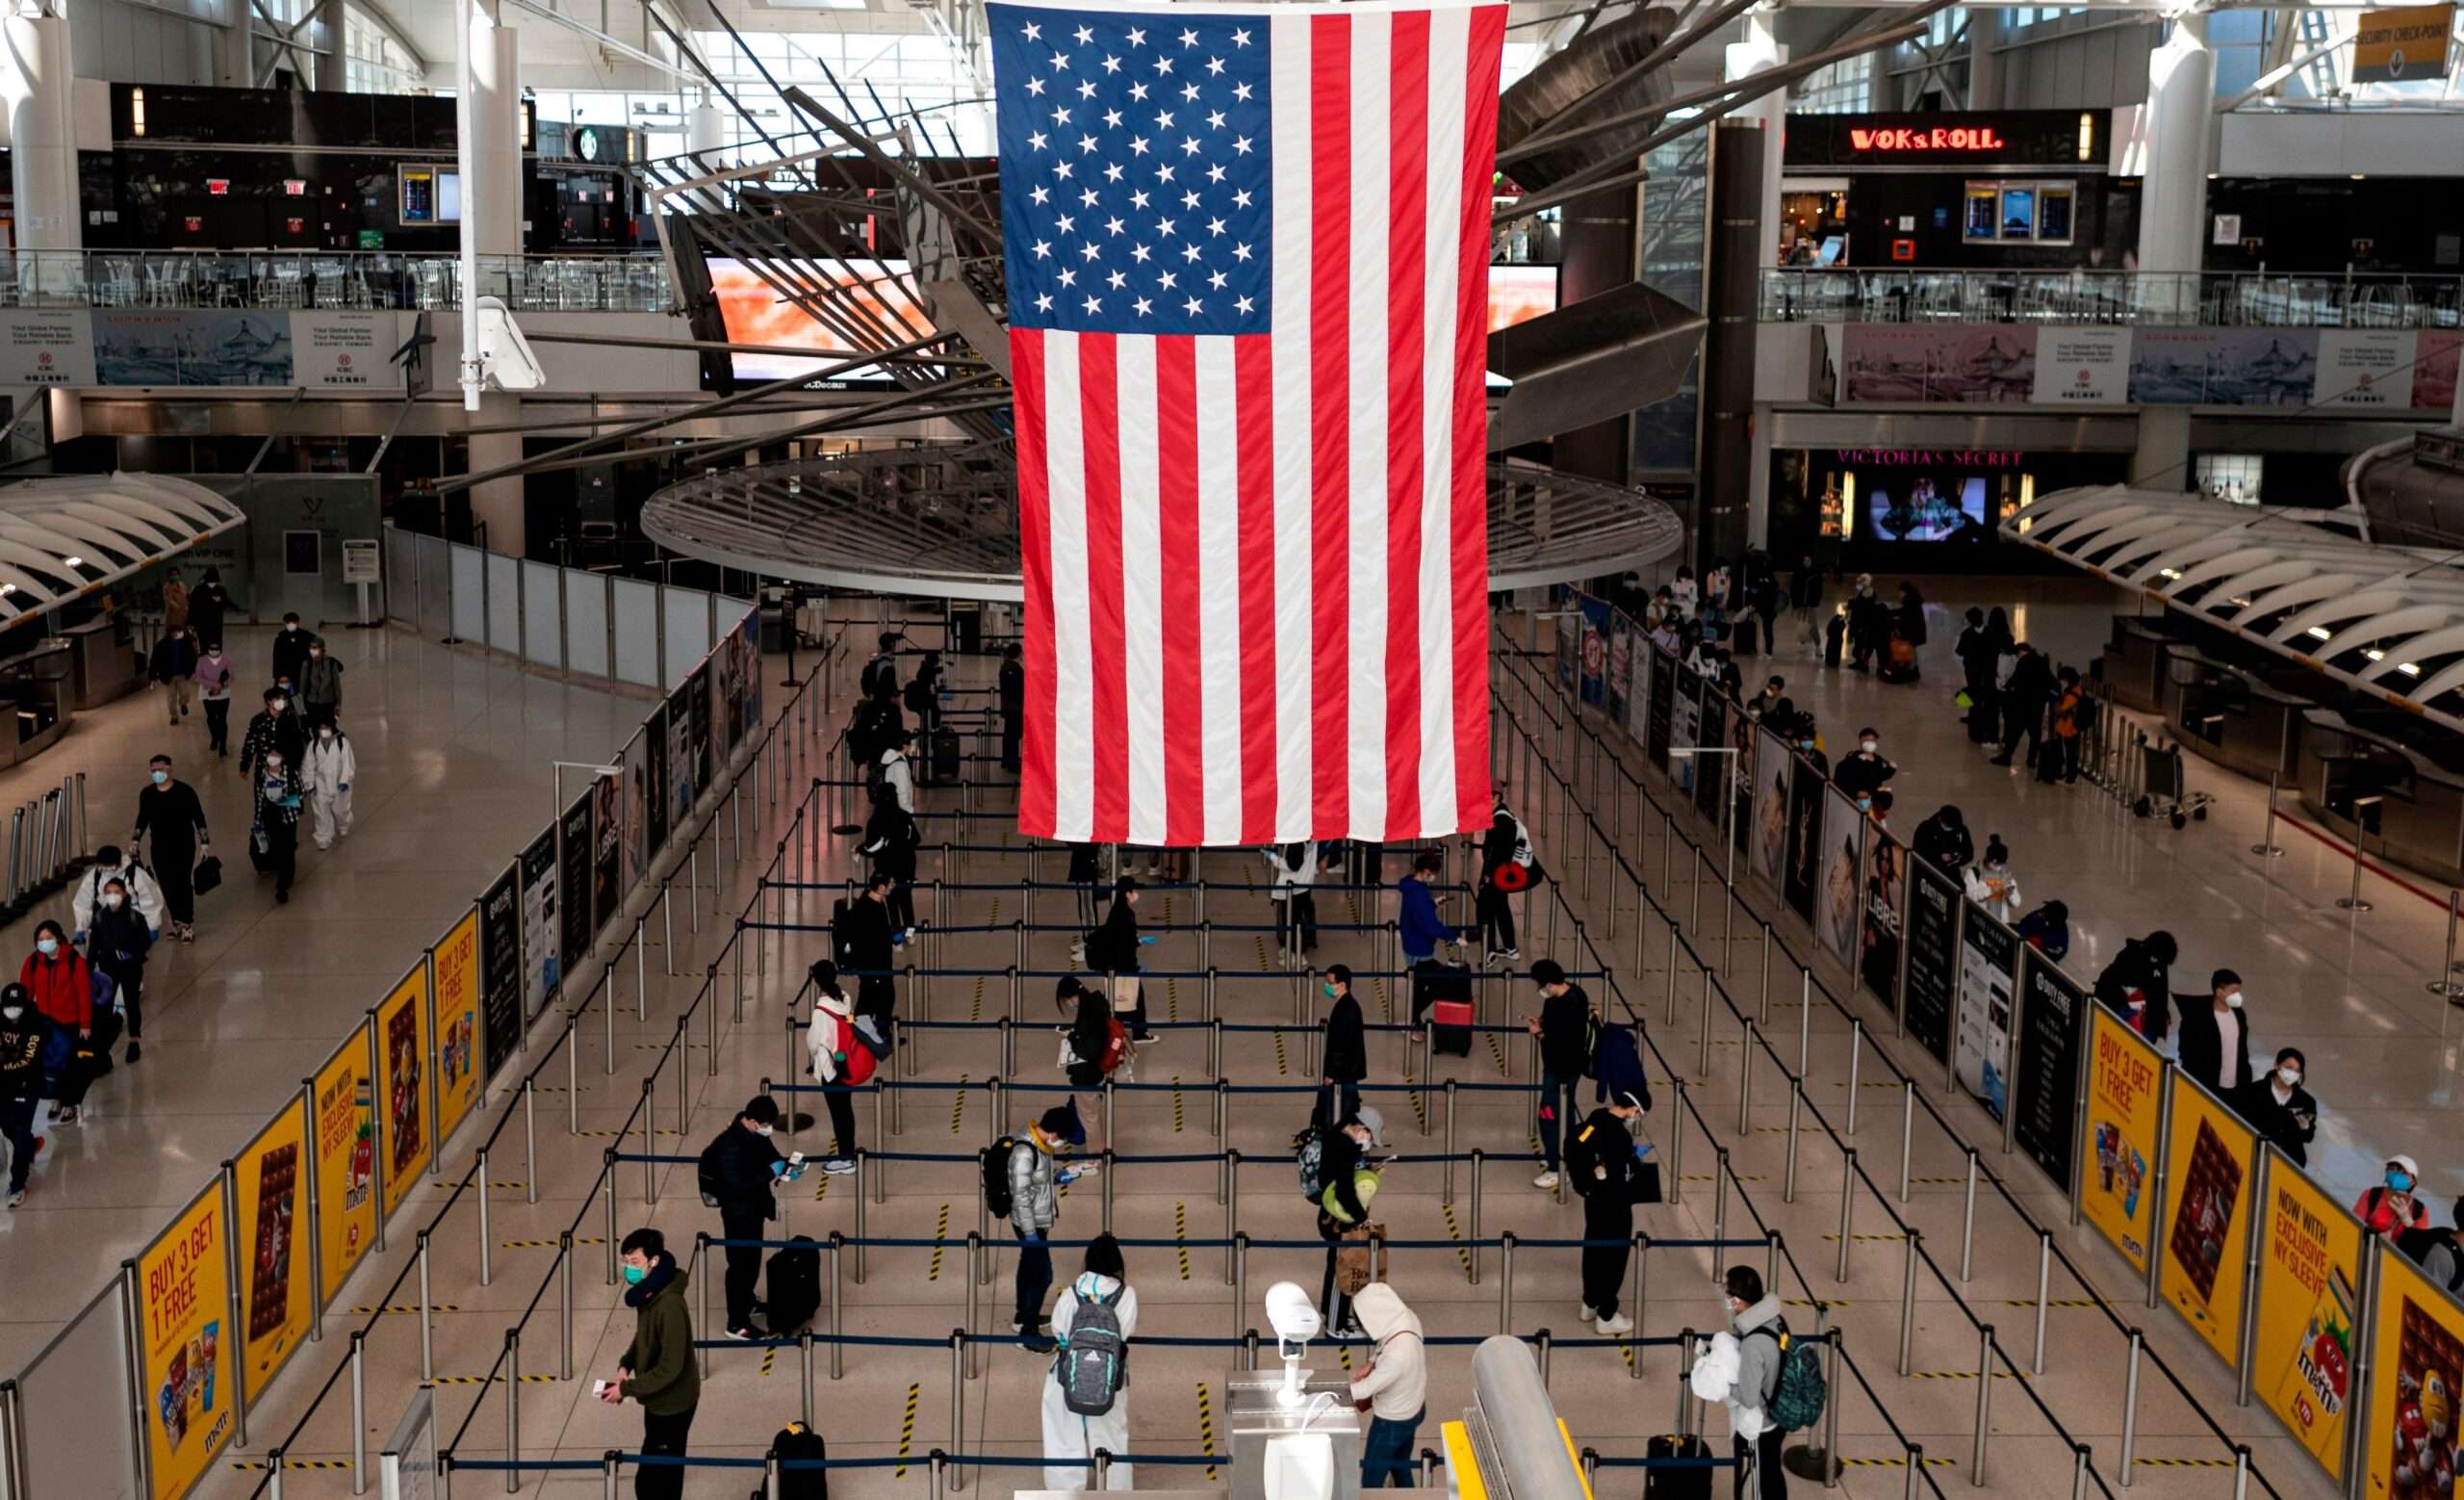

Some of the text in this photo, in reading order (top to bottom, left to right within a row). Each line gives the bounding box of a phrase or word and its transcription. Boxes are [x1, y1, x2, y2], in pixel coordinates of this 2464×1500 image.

[2357, 29, 2393, 45] SECURITY
[1851, 129, 1912, 149] WOK
[1837, 449, 2023, 465] VICTORIA'S SECRET
[1867, 889, 1902, 938] LIBRE
[2057, 987, 2071, 1015] FREE
[2100, 1031, 2153, 1097] BUY 3 GET
[321, 1066, 352, 1113] NOW WITH
[322, 1087, 354, 1139] EXCLUSIVE
[2107, 1068, 2134, 1113] FREE
[2278, 1186, 2327, 1249] NOW WITH
[150, 1209, 214, 1306] BUY 3 GET
[2274, 1236, 2288, 1264] NY
[2276, 1211, 2326, 1276] EXCLUSIVE
[153, 1307, 160, 1341] 1
[165, 1266, 198, 1331] FREE
